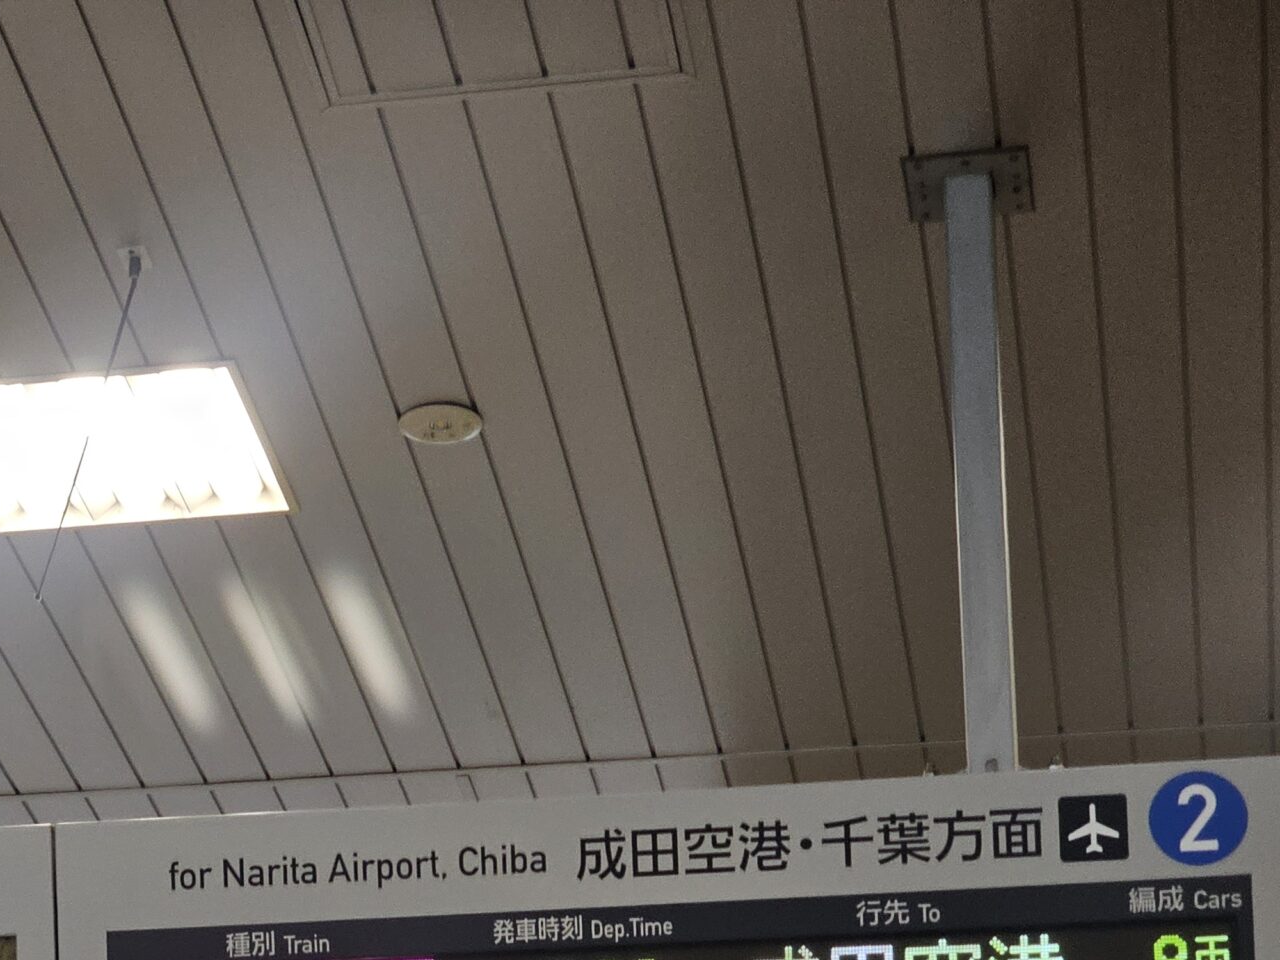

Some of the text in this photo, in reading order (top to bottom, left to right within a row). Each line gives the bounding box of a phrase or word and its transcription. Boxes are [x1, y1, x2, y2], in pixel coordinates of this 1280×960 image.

[1176, 783, 1219, 852] 2
[169, 844, 547, 890] for Narita Airport, Chiba
[856, 899, 941, 927] 行先 To
[1128, 886, 1243, 914] 編成 Cars
[225, 931, 330, 958] 種別 Train
[492, 915, 673, 945] 発車時刻 Dep.Time
